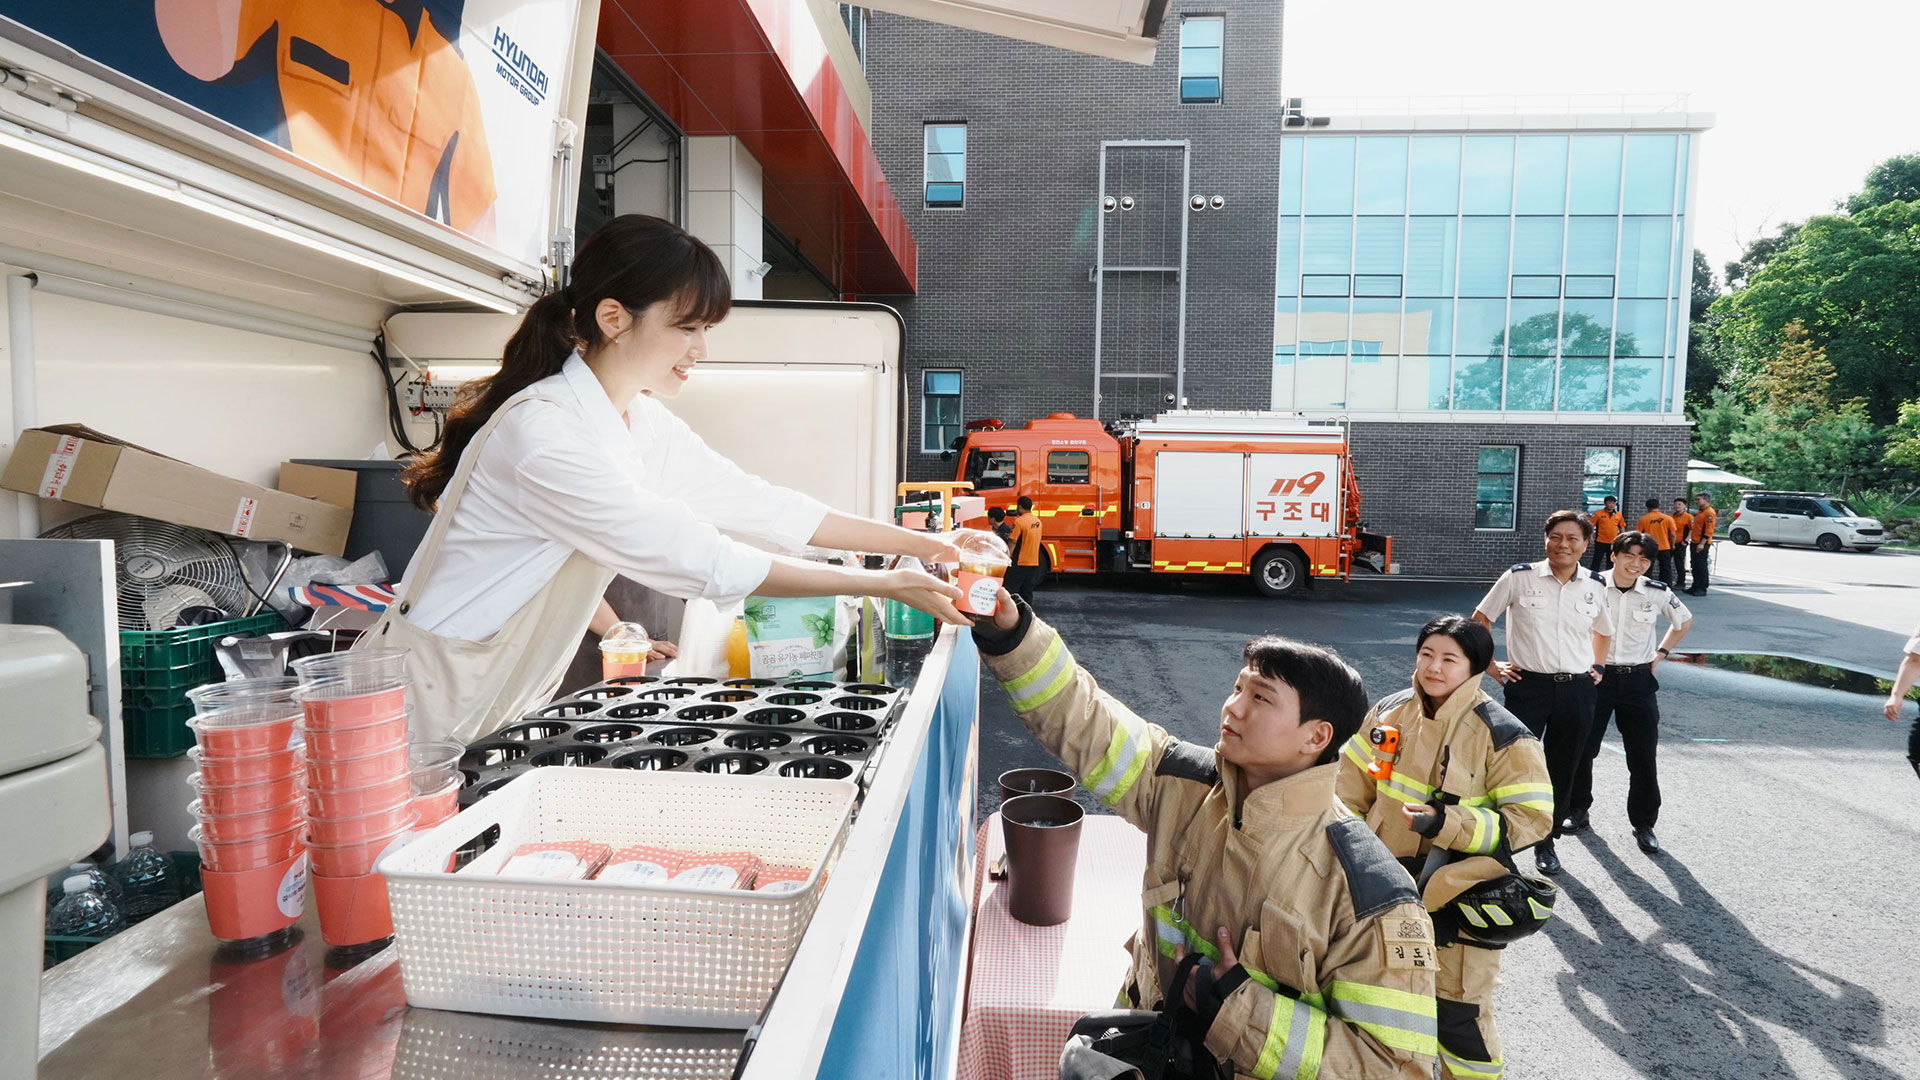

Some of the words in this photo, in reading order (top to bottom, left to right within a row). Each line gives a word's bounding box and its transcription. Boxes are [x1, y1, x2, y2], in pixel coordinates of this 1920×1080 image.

[494, 26, 548, 94] HYUNDAI
[496, 63, 519, 90] MOTOR
[519, 84, 540, 106] GROUP
[1267, 471, 1326, 496] 119
[1256, 501, 1330, 522] 구조대
[1031, 521, 1040, 529] 119
[762, 654, 776, 665] 곰곰
[778, 651, 798, 663] 유기농
